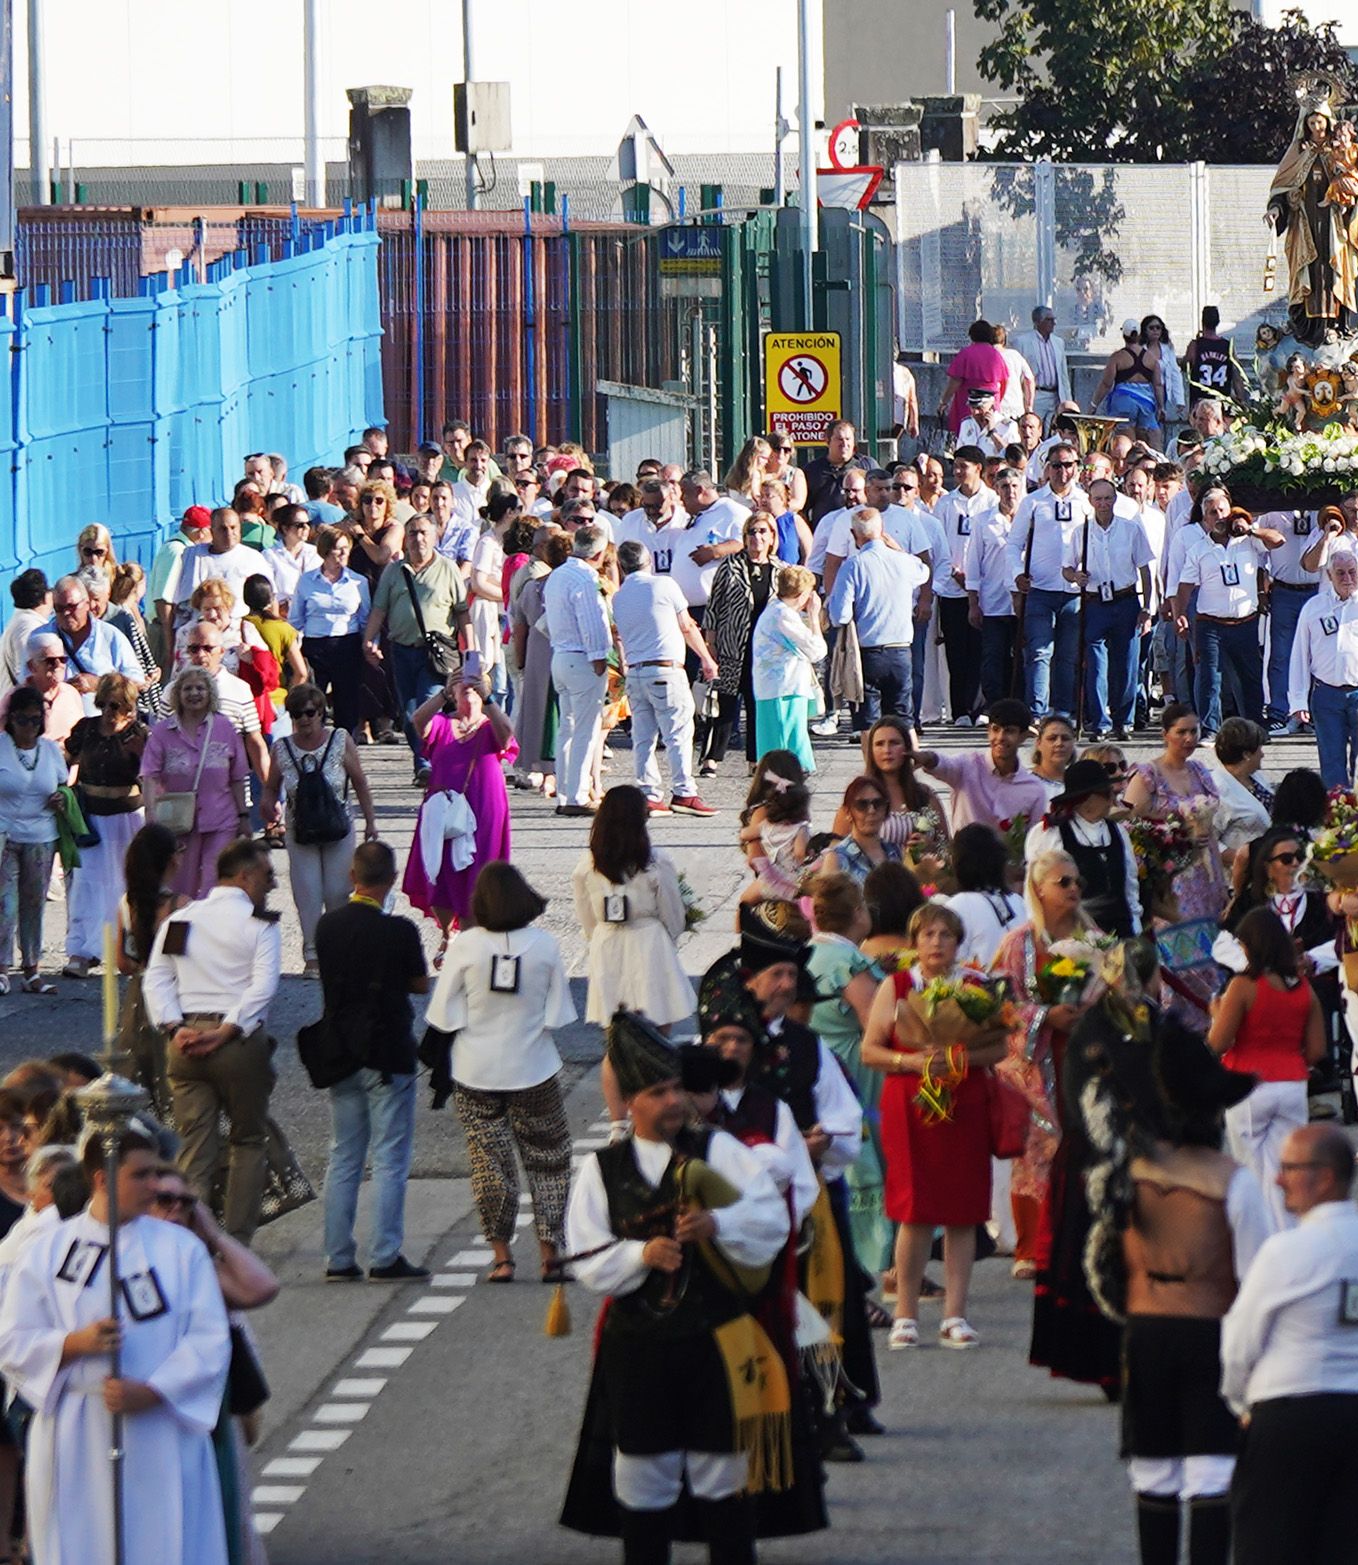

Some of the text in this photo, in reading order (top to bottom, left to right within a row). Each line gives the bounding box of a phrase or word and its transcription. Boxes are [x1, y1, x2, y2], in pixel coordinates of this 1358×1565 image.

[771, 336, 835, 349] ATENCIÓN
[1199, 364, 1228, 387] 34
[773, 412, 833, 422] PROHIBIDO
[775, 422, 788, 431] EL
[791, 422, 821, 431] PASO
